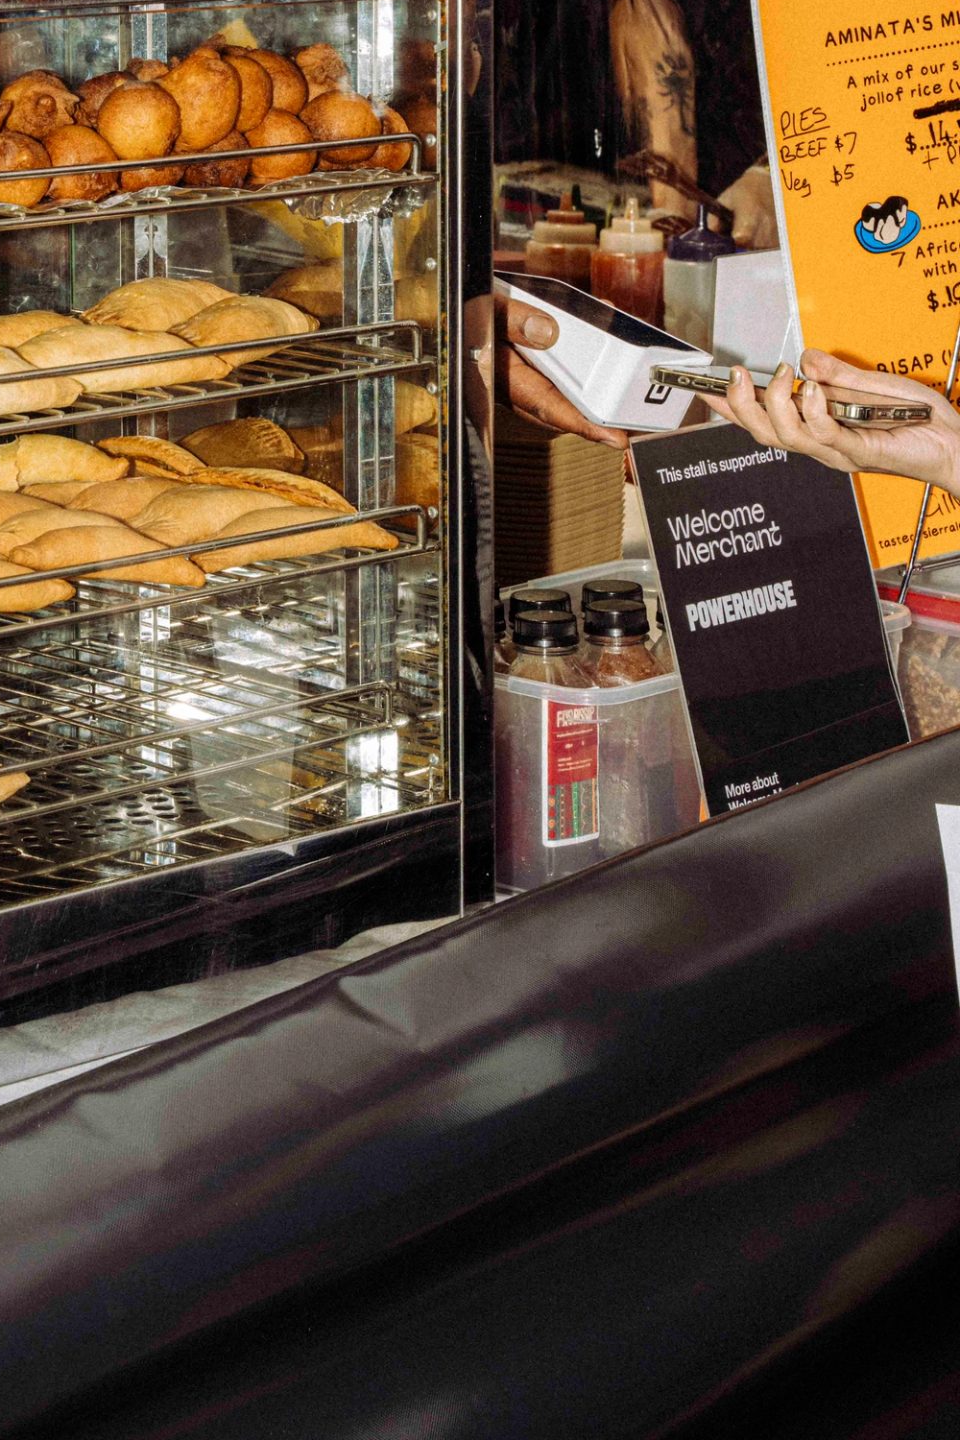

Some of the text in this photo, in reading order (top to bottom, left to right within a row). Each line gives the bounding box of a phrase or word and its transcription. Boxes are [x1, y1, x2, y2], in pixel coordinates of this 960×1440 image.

[825, 15, 933, 48] AMINATA'S
[847, 76, 858, 89] A
[863, 70, 889, 87] mix
[895, 64, 913, 80] of
[920, 62, 945, 76] our
[860, 86, 903, 112] jollof
[910, 82, 943, 98] rice
[780, 107, 828, 137] PIES
[780, 137, 827, 163] BEEF
[781, 169, 811, 198] Veg
[916, 239, 960, 259] Afric
[923, 259, 958, 278] with
[657, 447, 788, 484] This stall is supported by
[667, 503, 765, 542] Welcome
[676, 521, 782, 569] Merchant
[686, 580, 797, 632] POWERHOUSE
[725, 783, 751, 799] More
[752, 771, 780, 791] about
